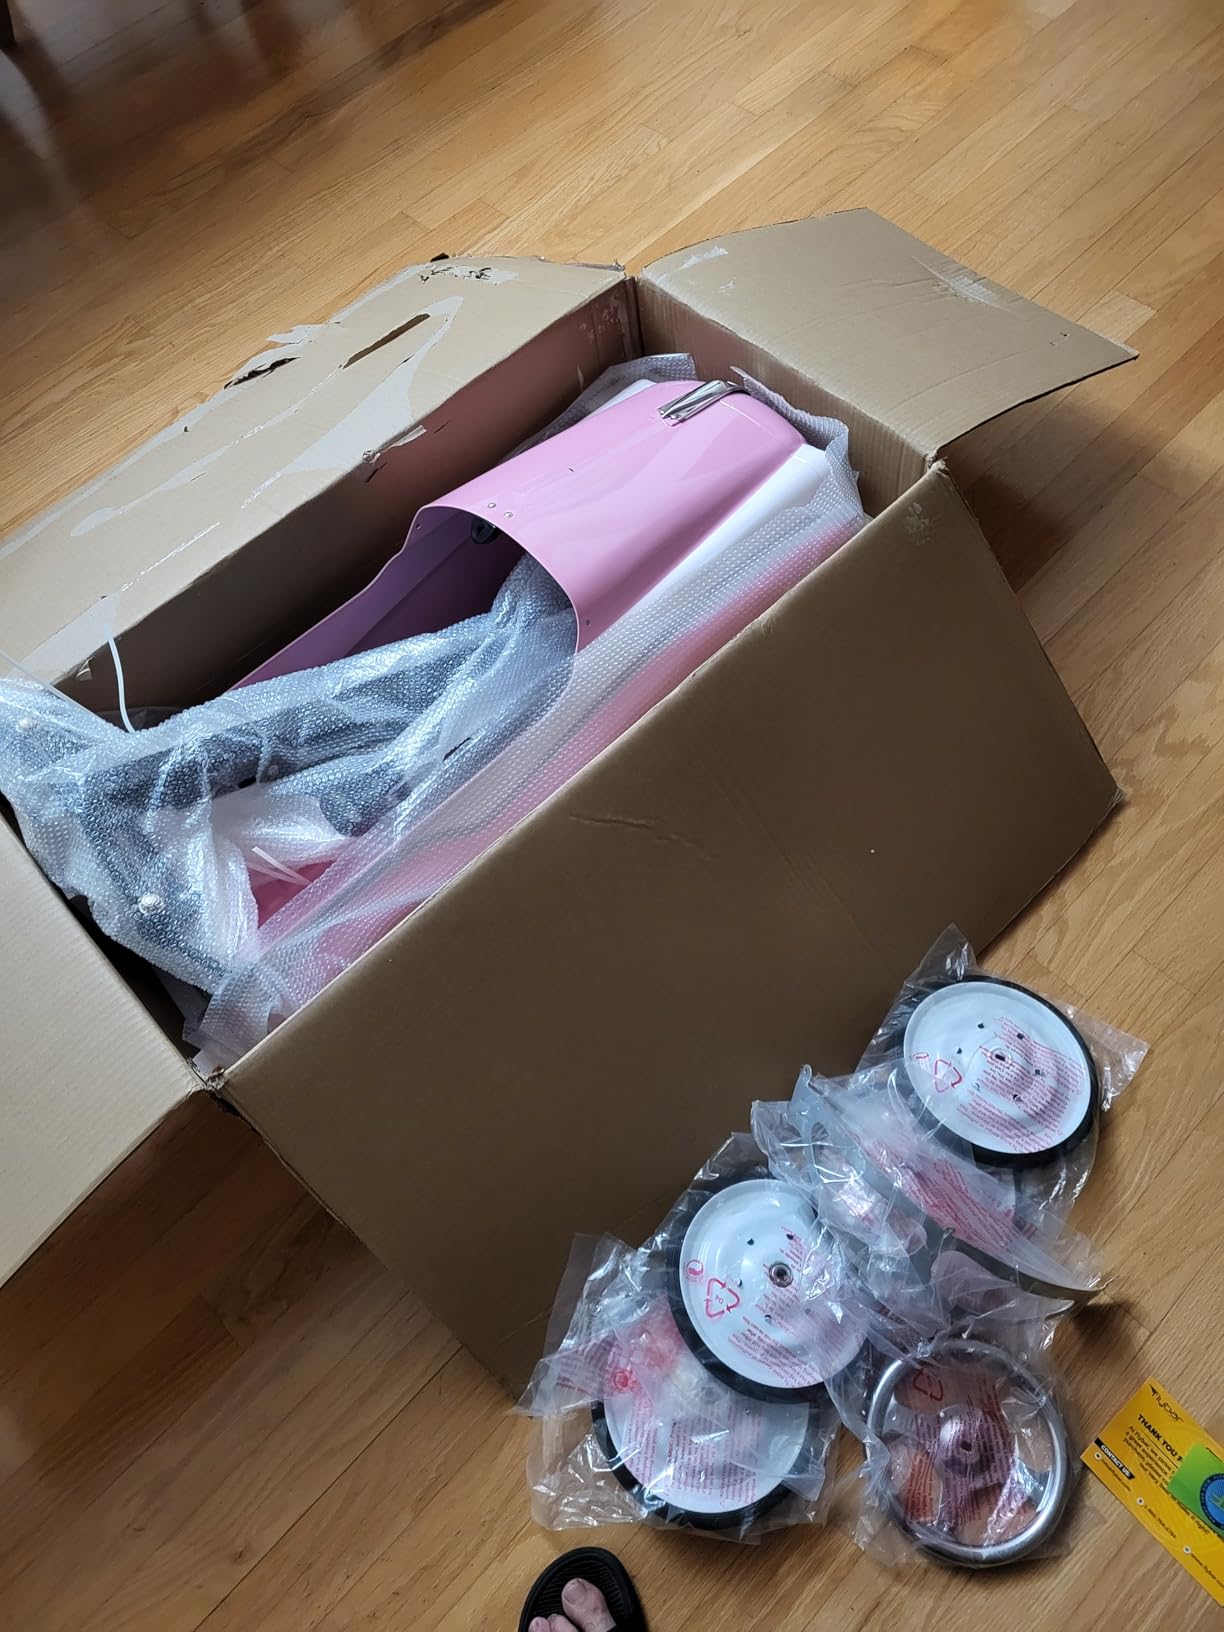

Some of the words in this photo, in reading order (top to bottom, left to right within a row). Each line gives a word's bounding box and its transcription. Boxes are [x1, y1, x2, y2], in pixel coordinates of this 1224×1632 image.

[1137, 1413, 1162, 1440] THANK
[1161, 1440, 1177, 1456] YOU
[1100, 1445, 1122, 1468] CONTACT
